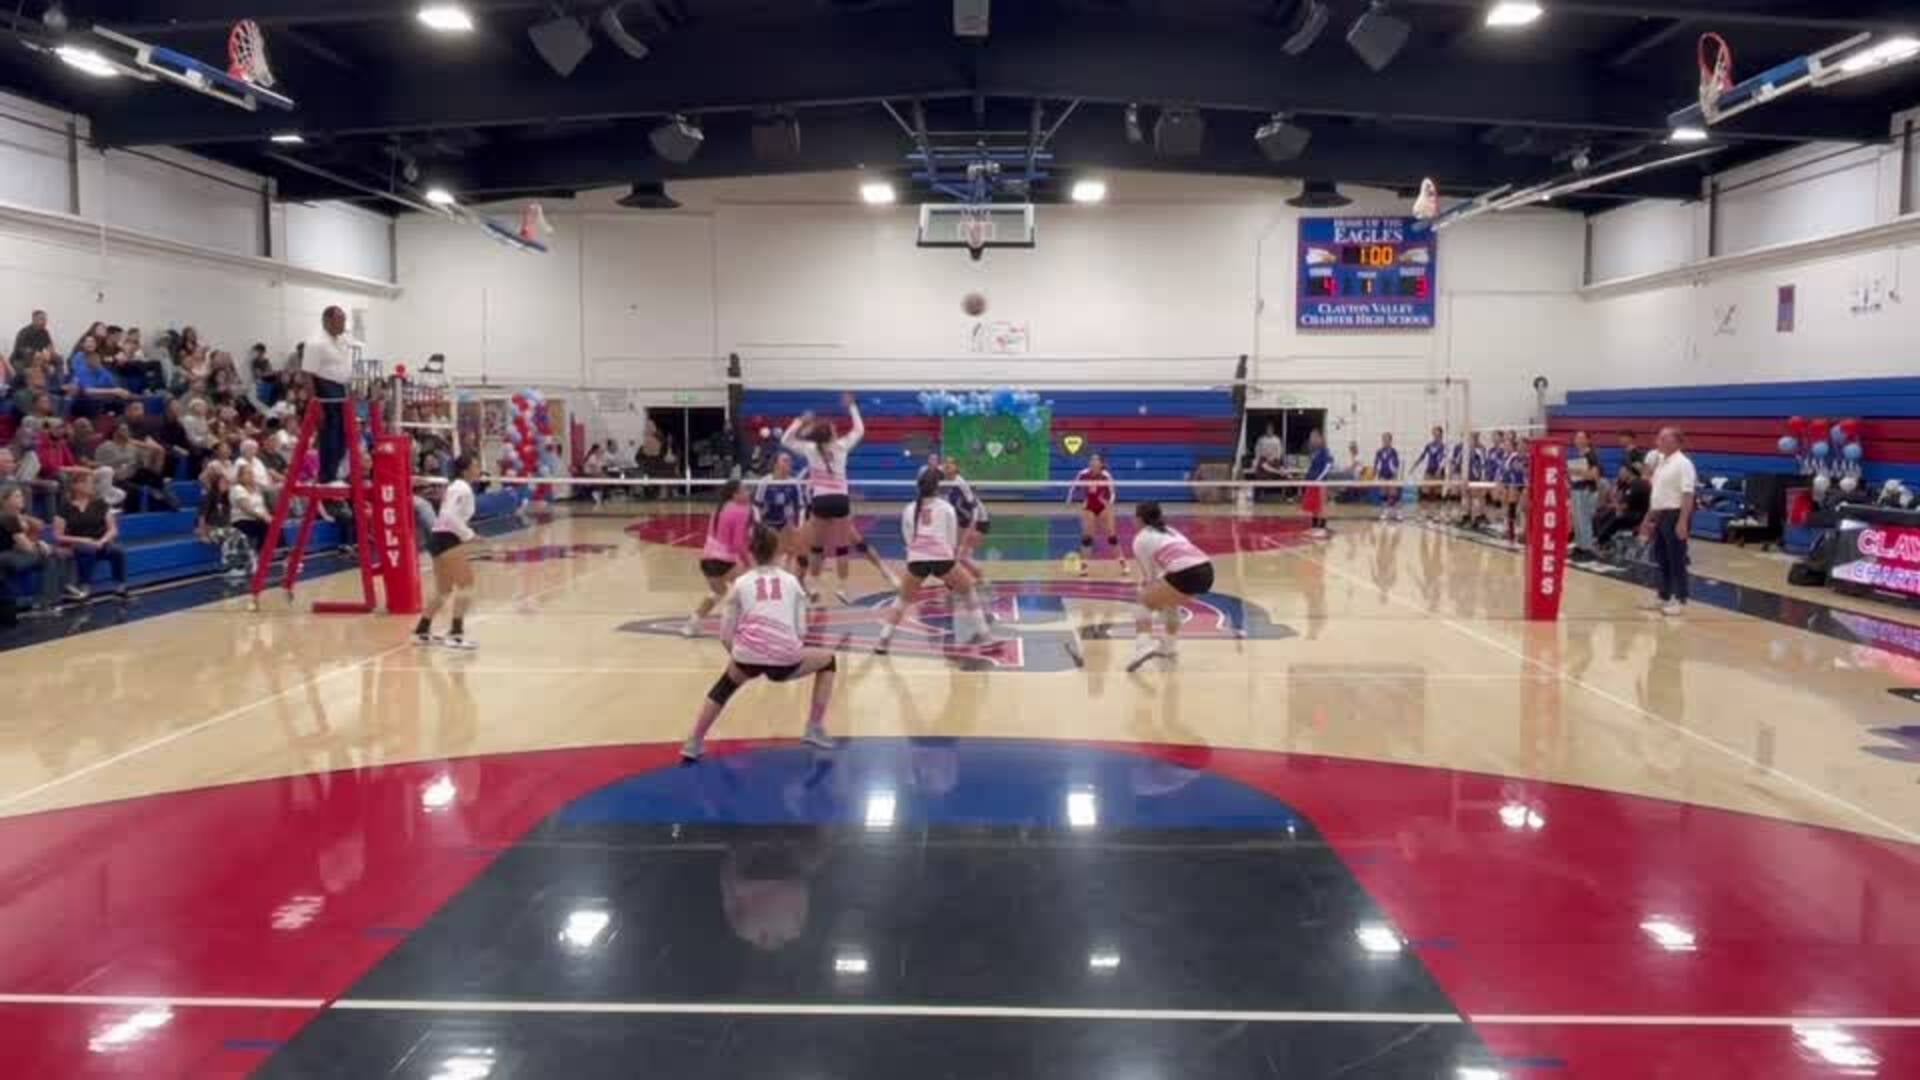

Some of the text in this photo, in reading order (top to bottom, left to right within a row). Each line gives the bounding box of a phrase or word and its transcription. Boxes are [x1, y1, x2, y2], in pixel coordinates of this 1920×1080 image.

[1334, 227, 1403, 242] EAGLES
[1371, 303, 1412, 313] VALLEY
[381, 485, 400, 567] UGLY
[1541, 467, 1558, 595] EAGLES
[754, 577, 783, 601] 11
